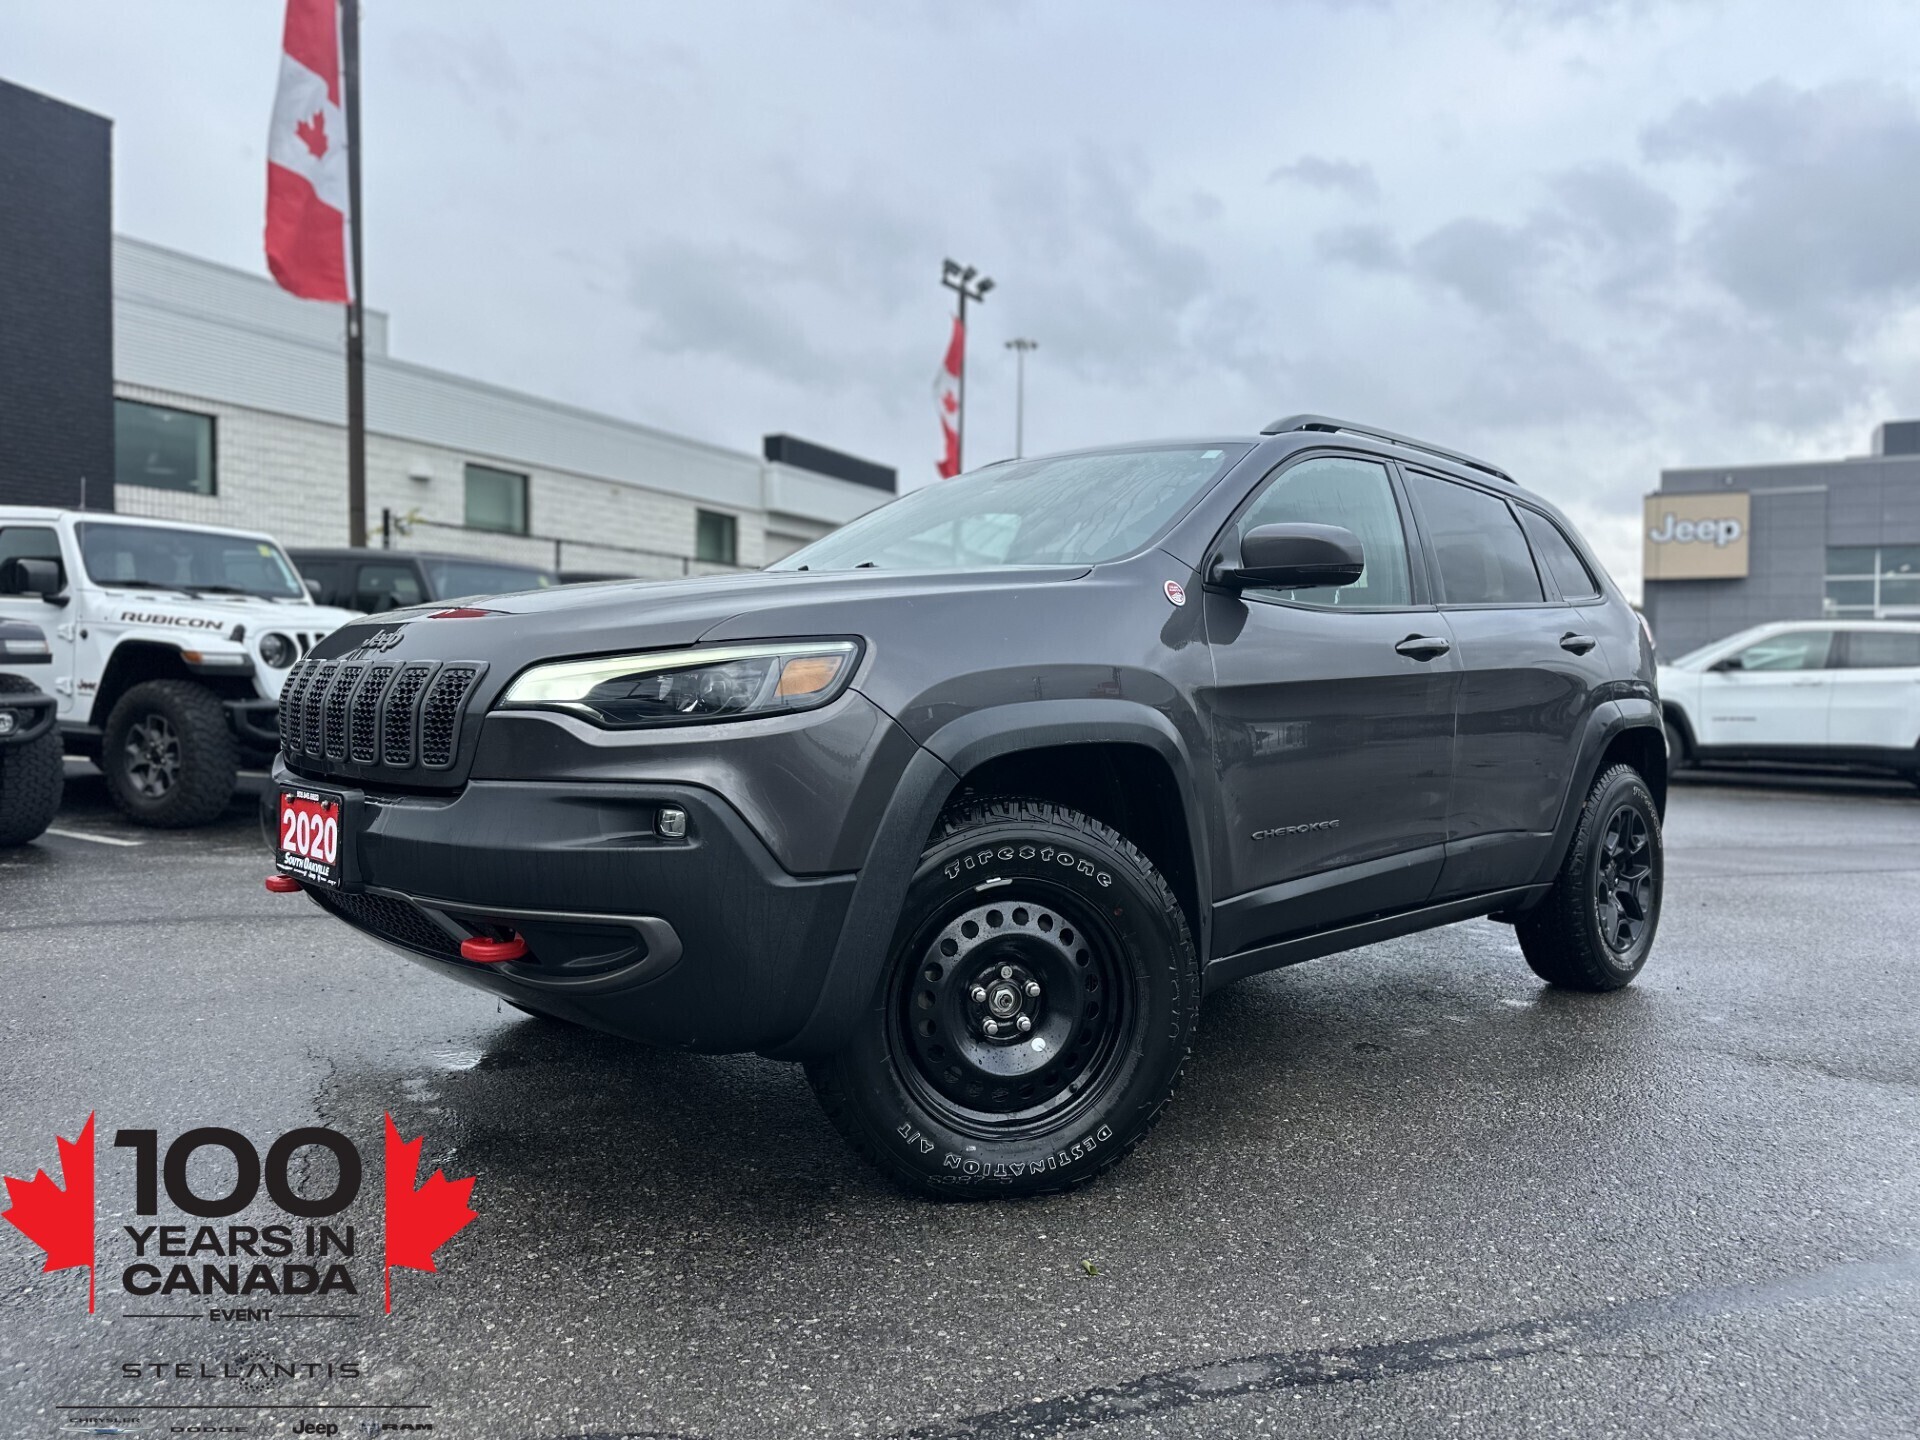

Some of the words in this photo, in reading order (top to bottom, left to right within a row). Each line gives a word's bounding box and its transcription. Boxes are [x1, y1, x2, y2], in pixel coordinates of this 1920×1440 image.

[1649, 513, 1742, 548] Jeep
[120, 611, 224, 630] RUBICON
[360, 629, 404, 653] Jeep
[283, 808, 338, 863] 2020
[1251, 819, 1340, 840] CHEROKEE
[944, 845, 1112, 888] Firestone
[897, 1122, 935, 1154] A/T
[944, 1125, 1113, 1177] DESTINATION
